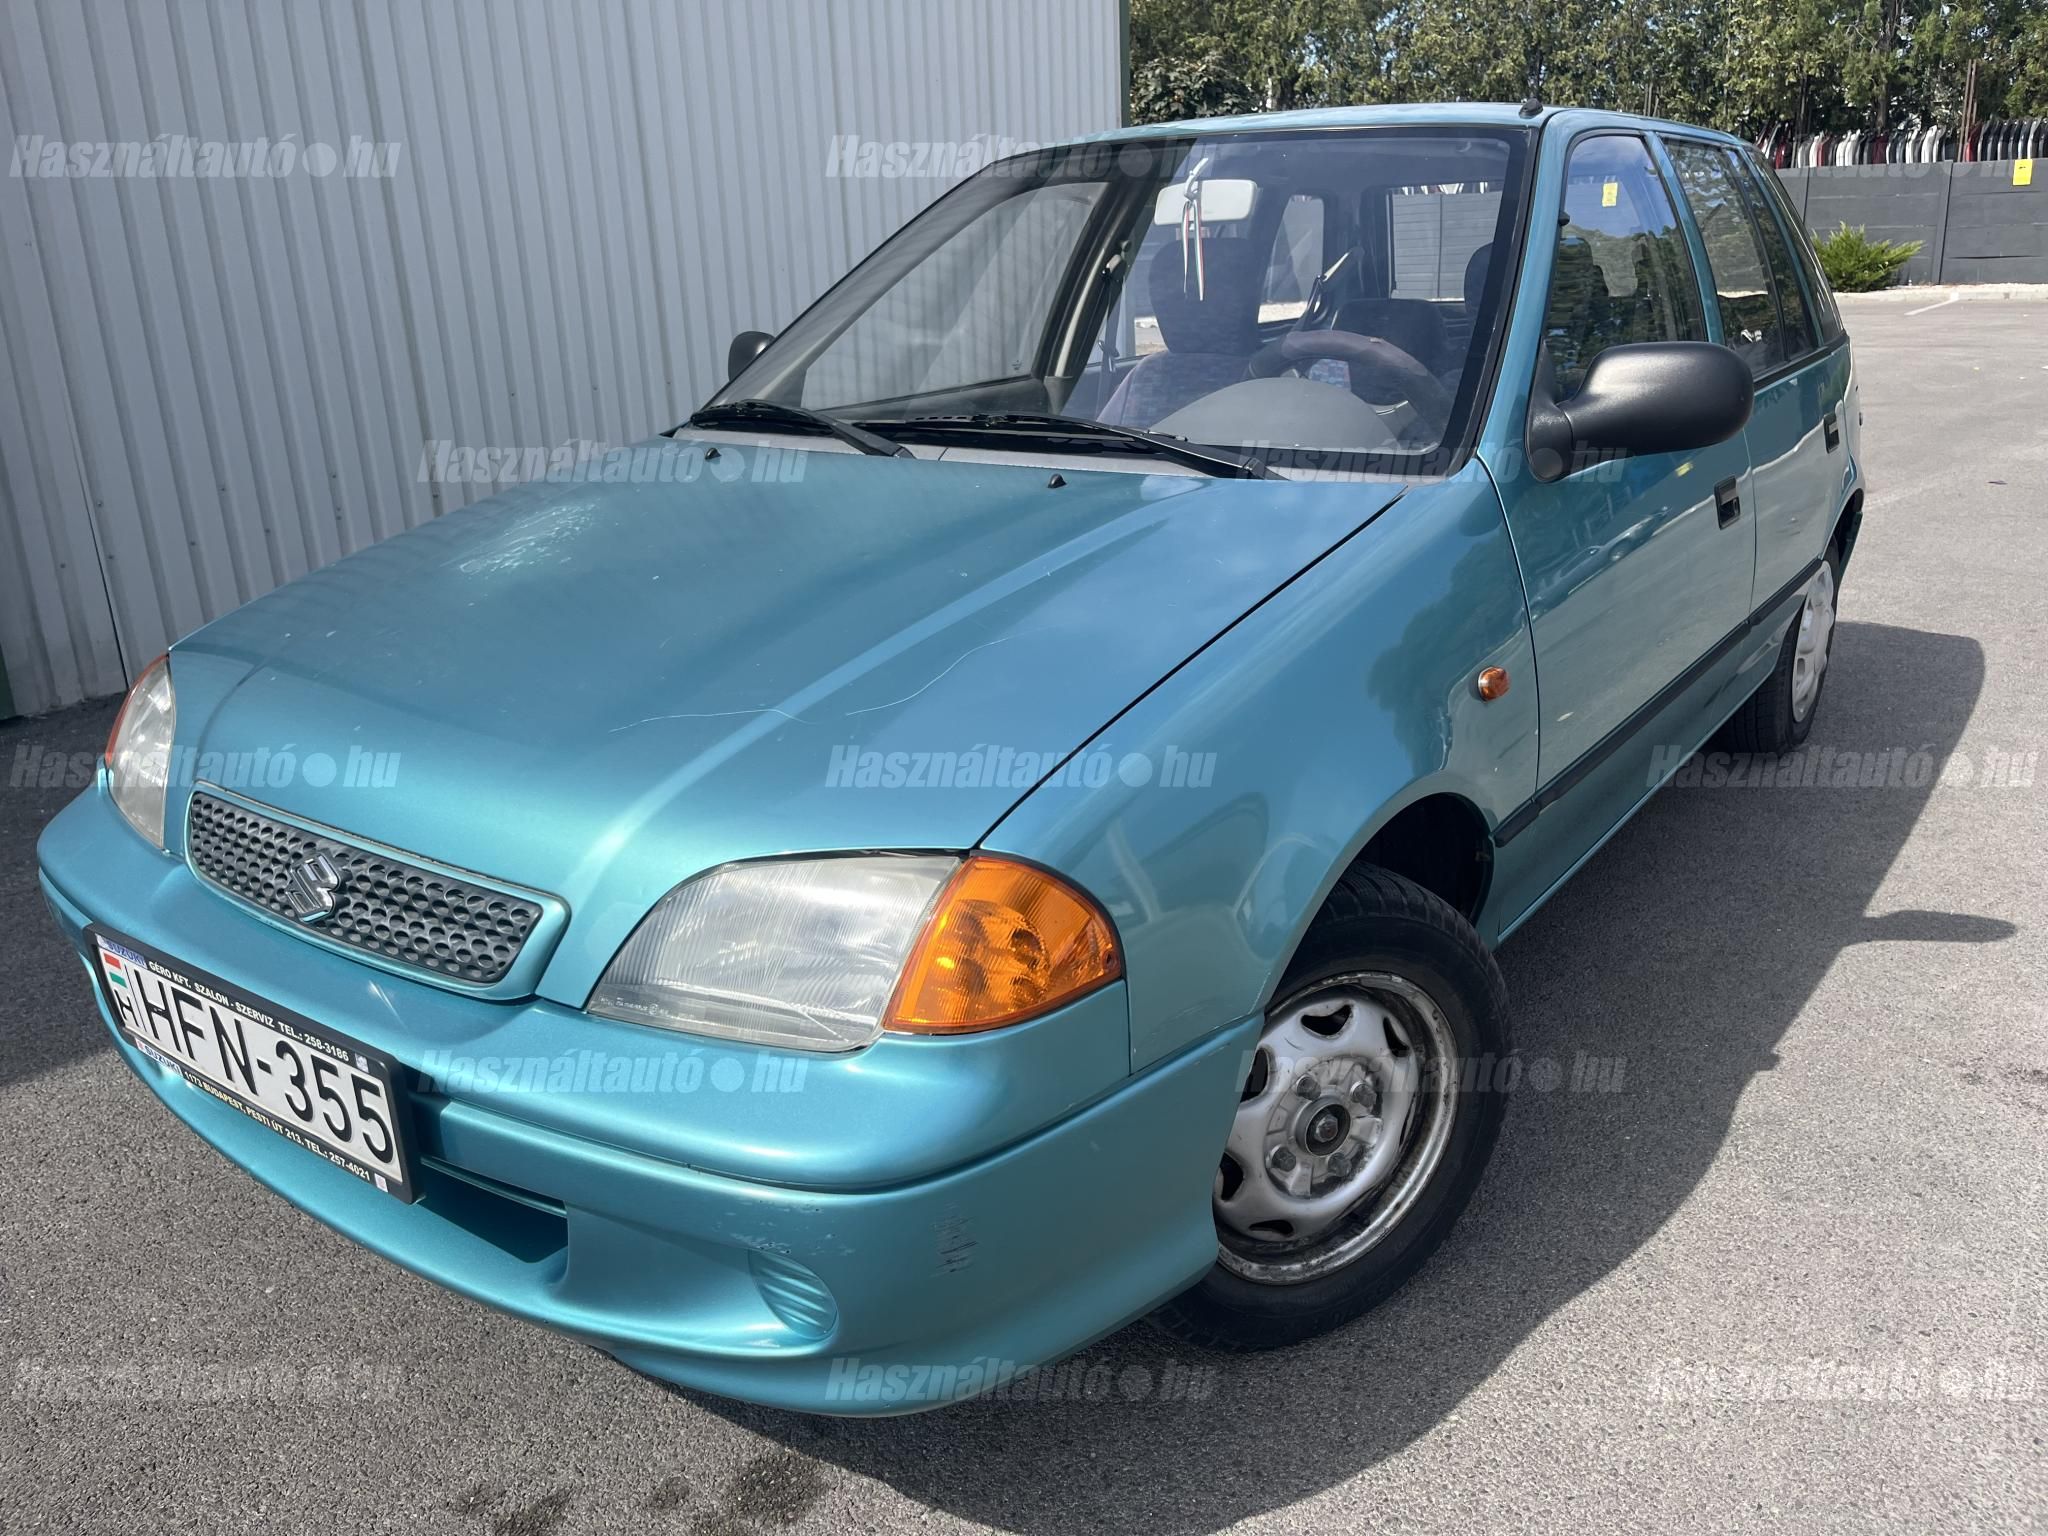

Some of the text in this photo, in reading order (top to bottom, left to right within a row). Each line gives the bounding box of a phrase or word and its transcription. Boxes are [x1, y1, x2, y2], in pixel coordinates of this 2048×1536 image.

[105, 939, 146, 967] SUZUKI
[172, 971, 192, 989] KFT.
[194, 982, 230, 1007] SZALON
[236, 1001, 275, 1028] SZERVIZ
[277, 1021, 303, 1041] TEL.:
[304, 1033, 350, 1062] 258-3186
[113, 988, 140, 1028] H
[133, 969, 394, 1165] HFN-355
[144, 1045, 182, 1075] SUZUKI
[184, 1071, 203, 1089] 1173
[246, 1105, 271, 1128] PESTI
[271, 1115, 284, 1135] ÚT
[305, 1138, 328, 1159] TEL.:
[329, 1151, 371, 1181] 257-4021
